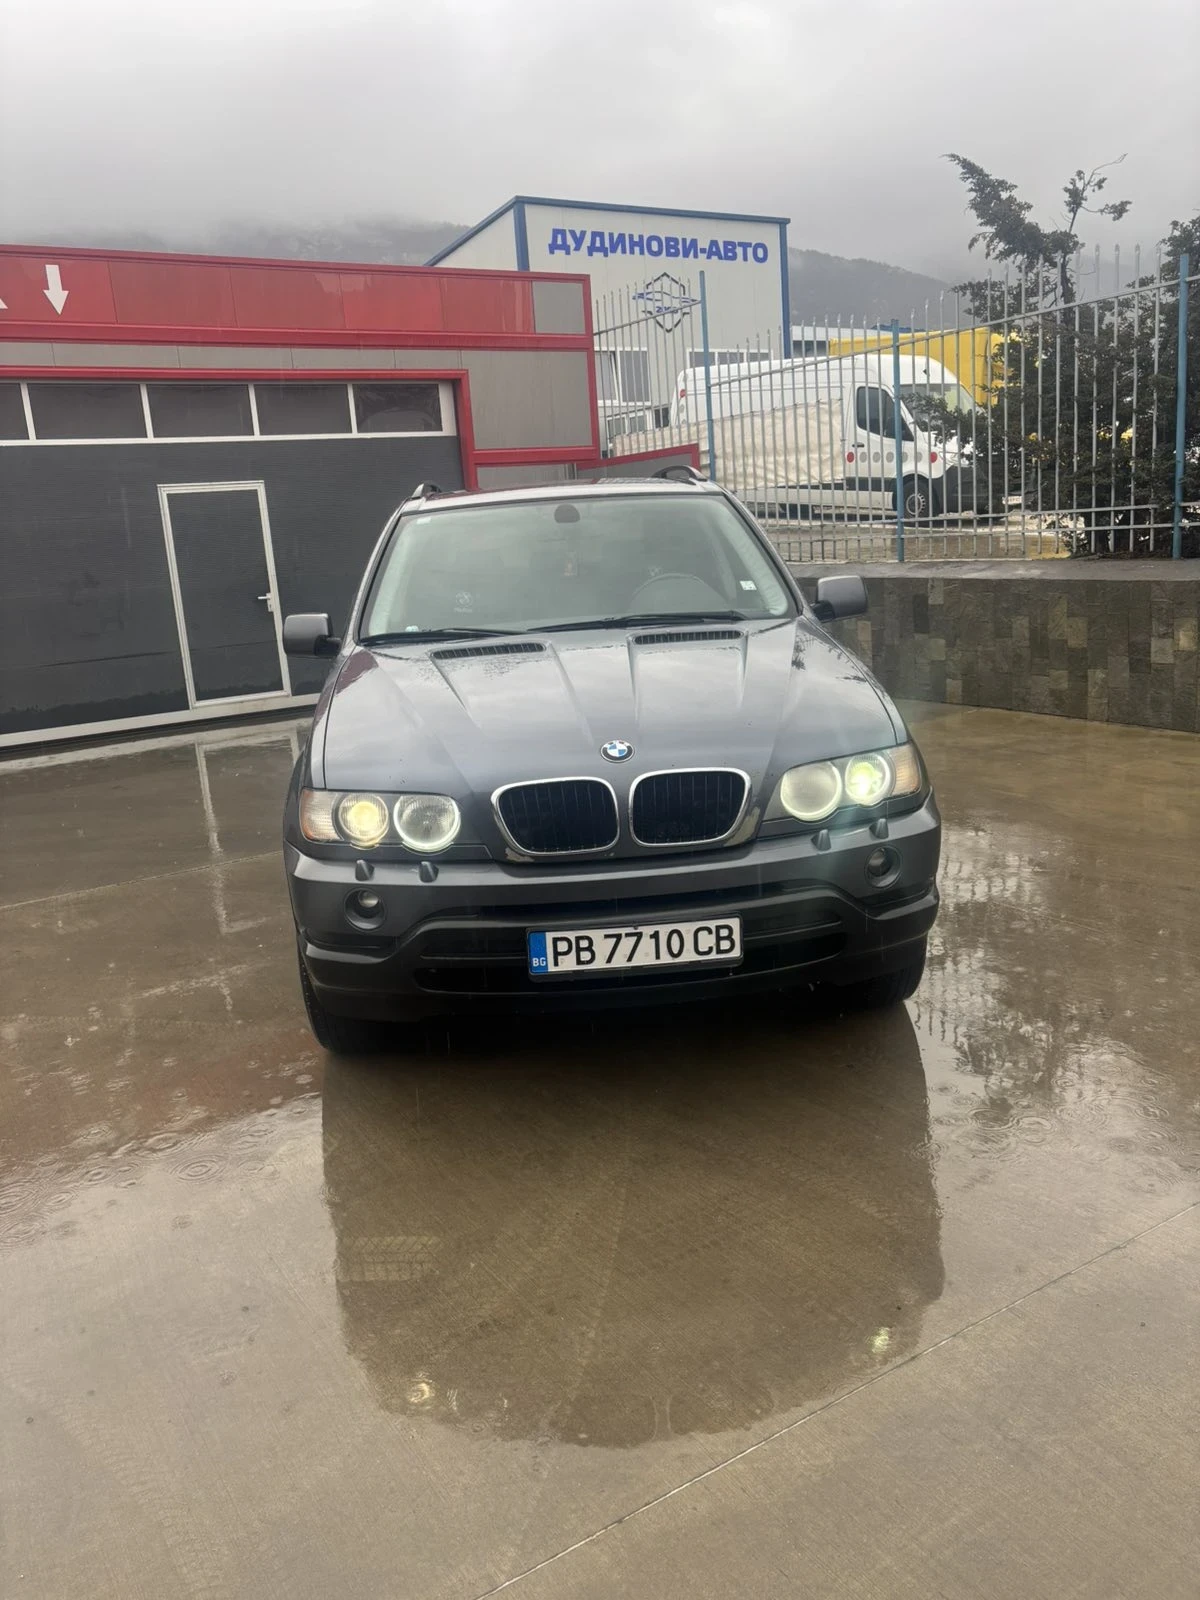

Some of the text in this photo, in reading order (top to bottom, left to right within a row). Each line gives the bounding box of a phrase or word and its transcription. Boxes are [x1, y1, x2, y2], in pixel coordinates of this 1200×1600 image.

[548, 228, 769, 263] ДУДИНОВИ-АВТО
[532, 957, 546, 967] BG
[552, 924, 736, 967] PB 7710 CB
